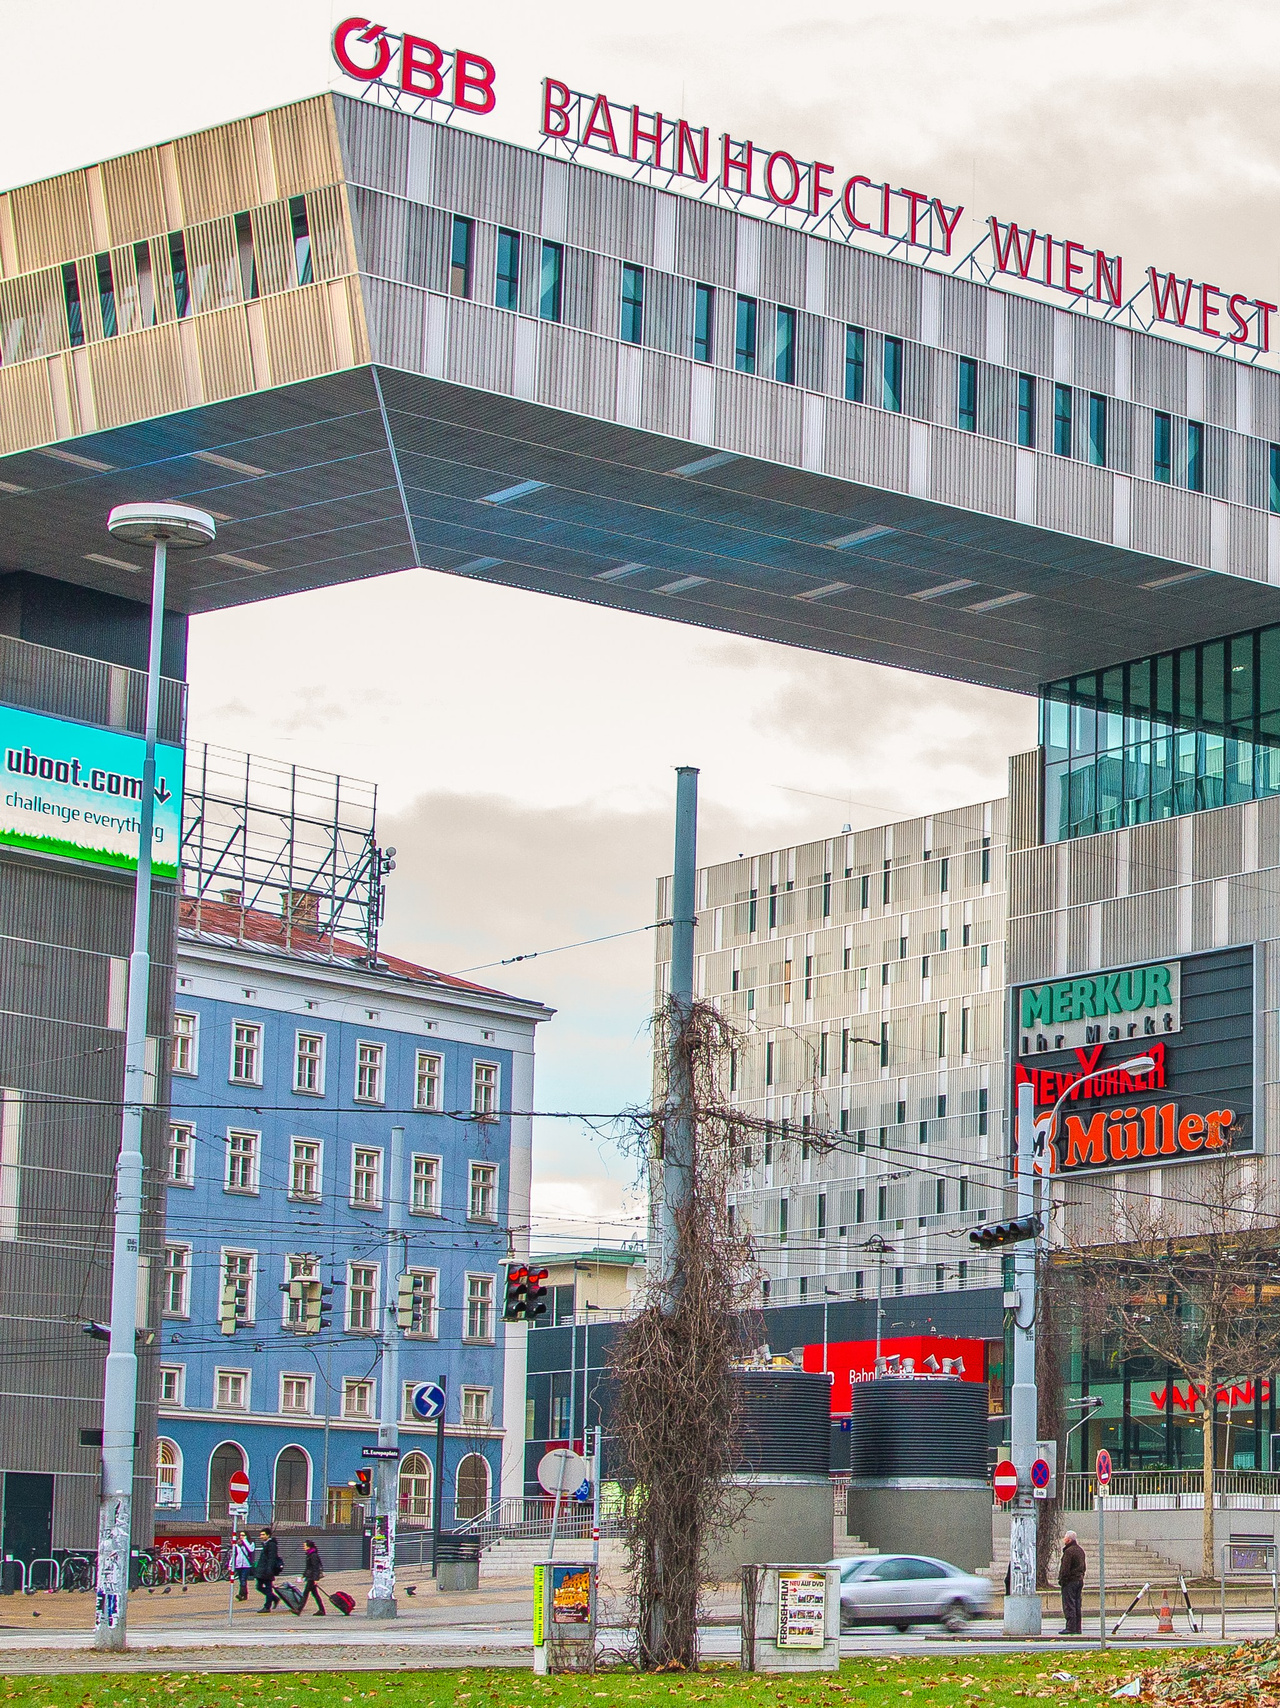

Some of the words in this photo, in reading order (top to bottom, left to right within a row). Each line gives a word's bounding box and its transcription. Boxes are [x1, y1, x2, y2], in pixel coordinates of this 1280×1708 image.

[331, 16, 496, 115] ÖBB
[542, 77, 964, 256] BAHNHOFCITY
[987, 216, 1122, 308] WIEN
[1146, 267, 1278, 353] WEST
[6, 746, 144, 800] uboot.com
[6, 791, 80, 823] challenge
[84, 811, 164, 843] everythg
[1021, 965, 1173, 1028] MERKUR
[1086, 1013, 1173, 1045] Markt
[1064, 1102, 1236, 1167] Müller
[1150, 1380, 1271, 1413] VAPANO
[780, 1580, 789, 1645] FERNSEH-FILM
